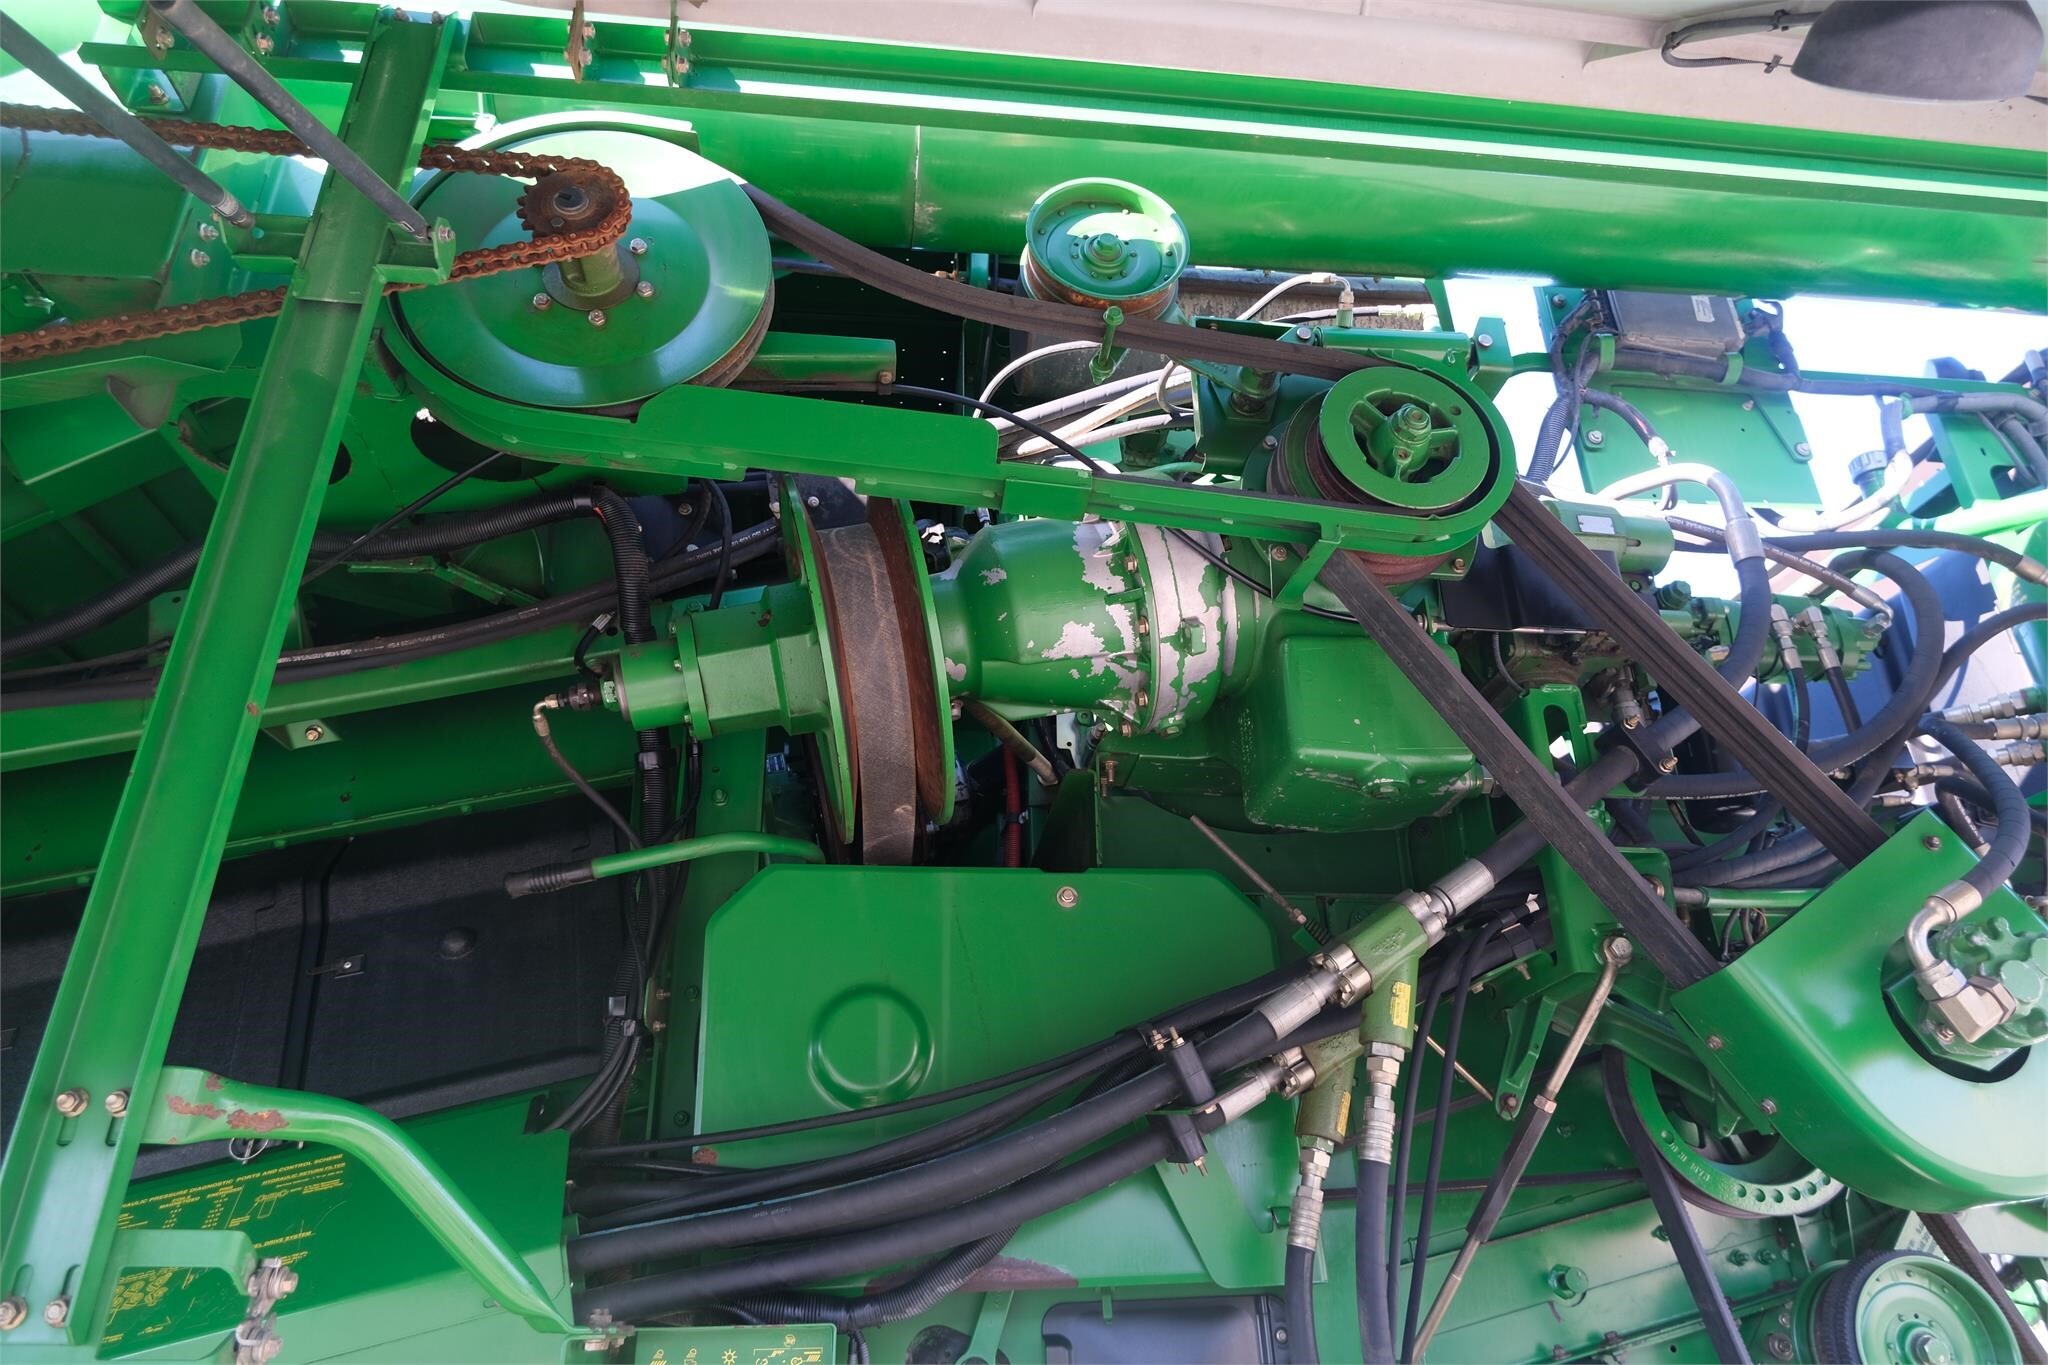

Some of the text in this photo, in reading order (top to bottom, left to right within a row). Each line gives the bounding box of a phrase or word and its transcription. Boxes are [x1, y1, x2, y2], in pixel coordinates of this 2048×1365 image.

[189, 1179, 234, 1193] DIAGNOSTIC
[262, 1168, 278, 1177] AND
[278, 1161, 312, 1173] CONTROL
